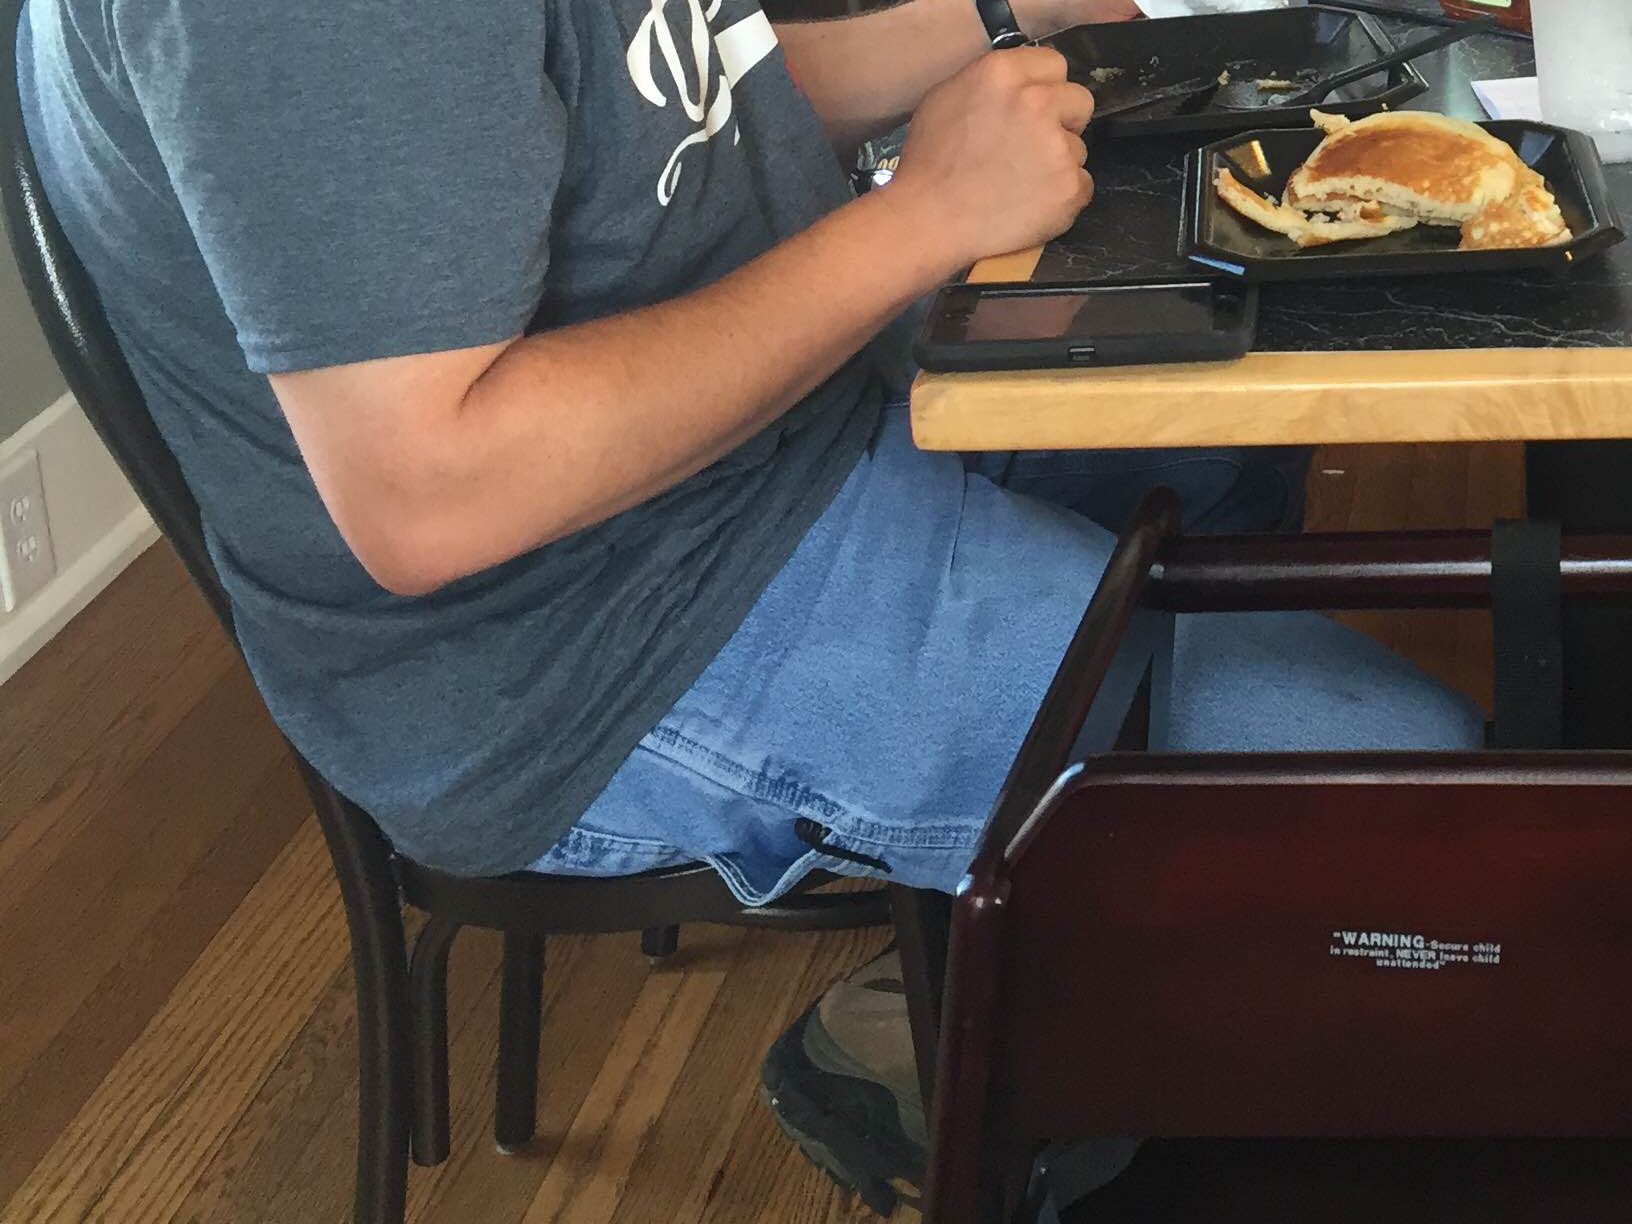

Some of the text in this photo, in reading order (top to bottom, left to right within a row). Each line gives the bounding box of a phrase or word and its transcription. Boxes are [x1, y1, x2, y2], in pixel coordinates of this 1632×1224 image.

[1330, 945, 1341, 955] in
[1396, 949, 1436, 961] NEVER
[1473, 954, 1500, 964] child
[1473, 943, 1501, 954] child
